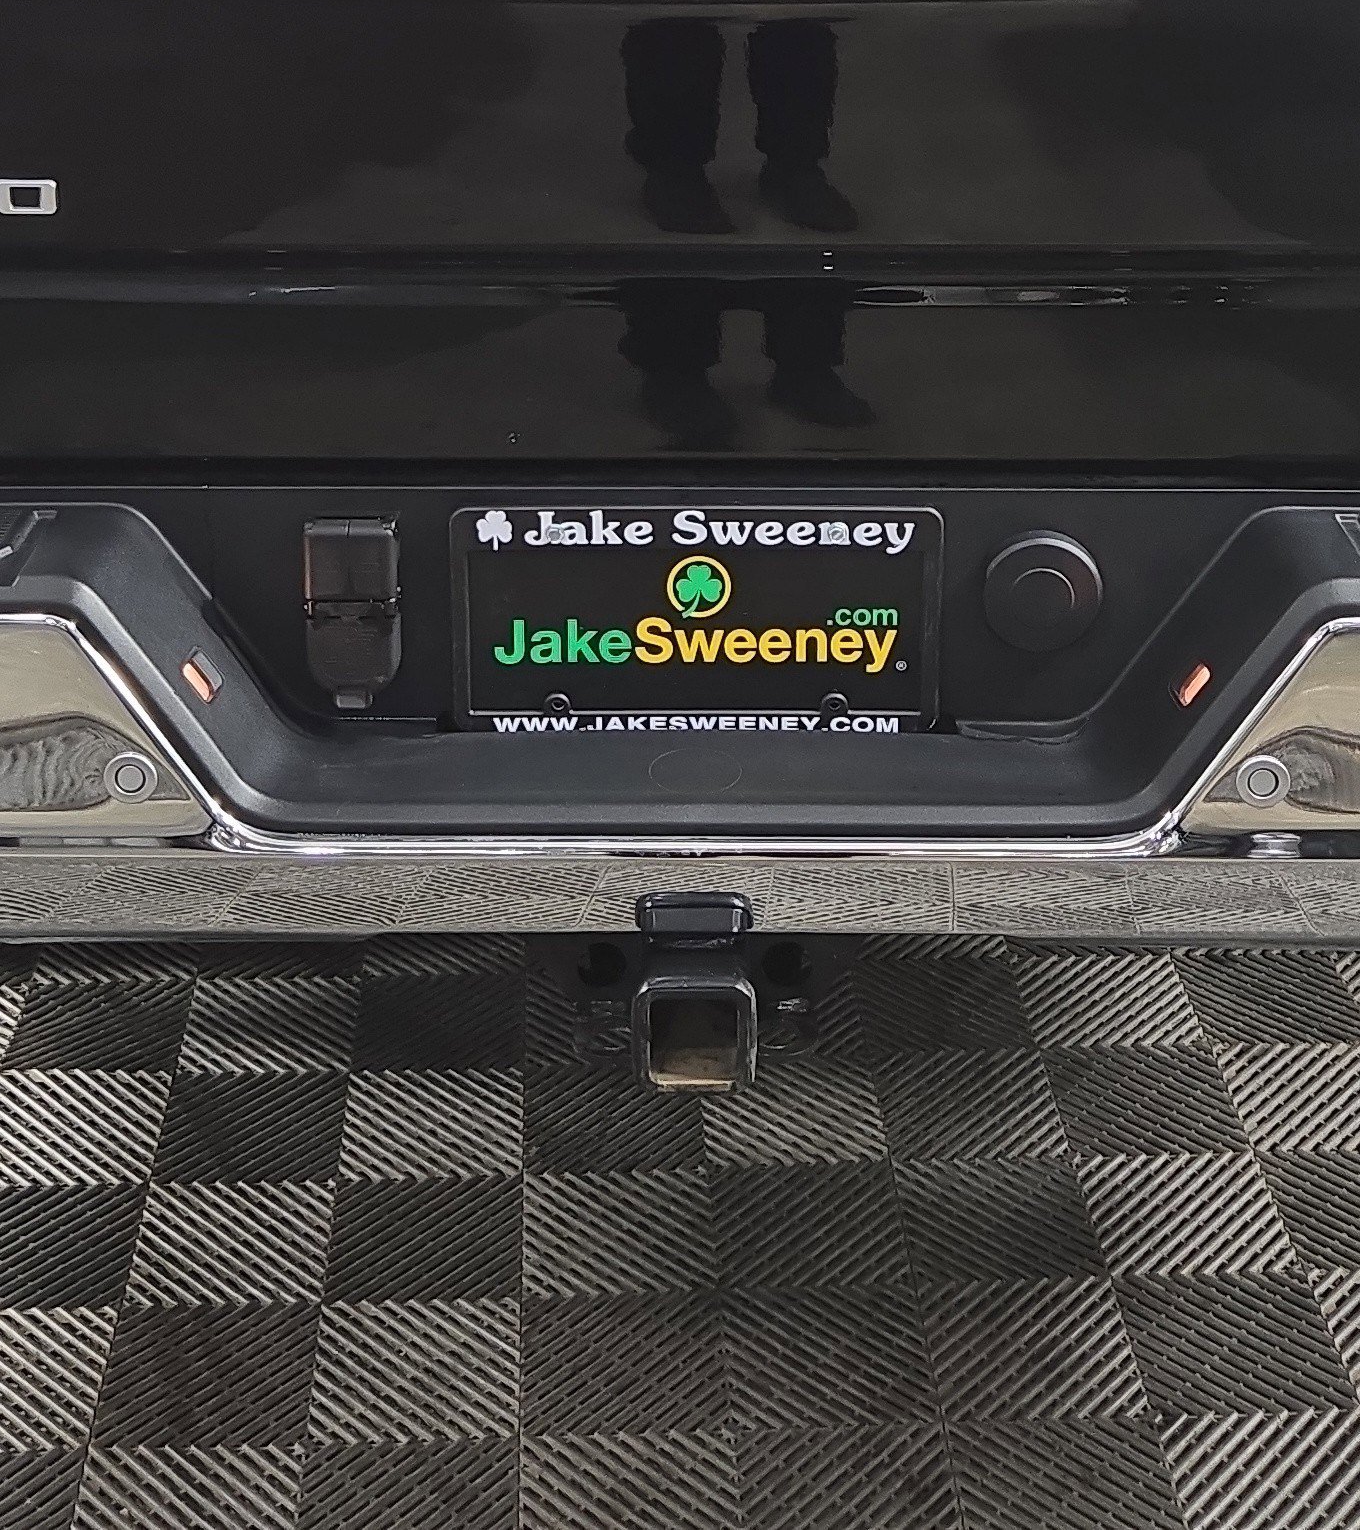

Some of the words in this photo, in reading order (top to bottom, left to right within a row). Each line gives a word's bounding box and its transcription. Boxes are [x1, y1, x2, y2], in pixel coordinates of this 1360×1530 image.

[524, 510, 654, 546] Jake
[671, 510, 915, 555] Sweeney
[826, 608, 898, 626] .com
[492, 716, 900, 734] WWW.JAKESWEENEY.COM
